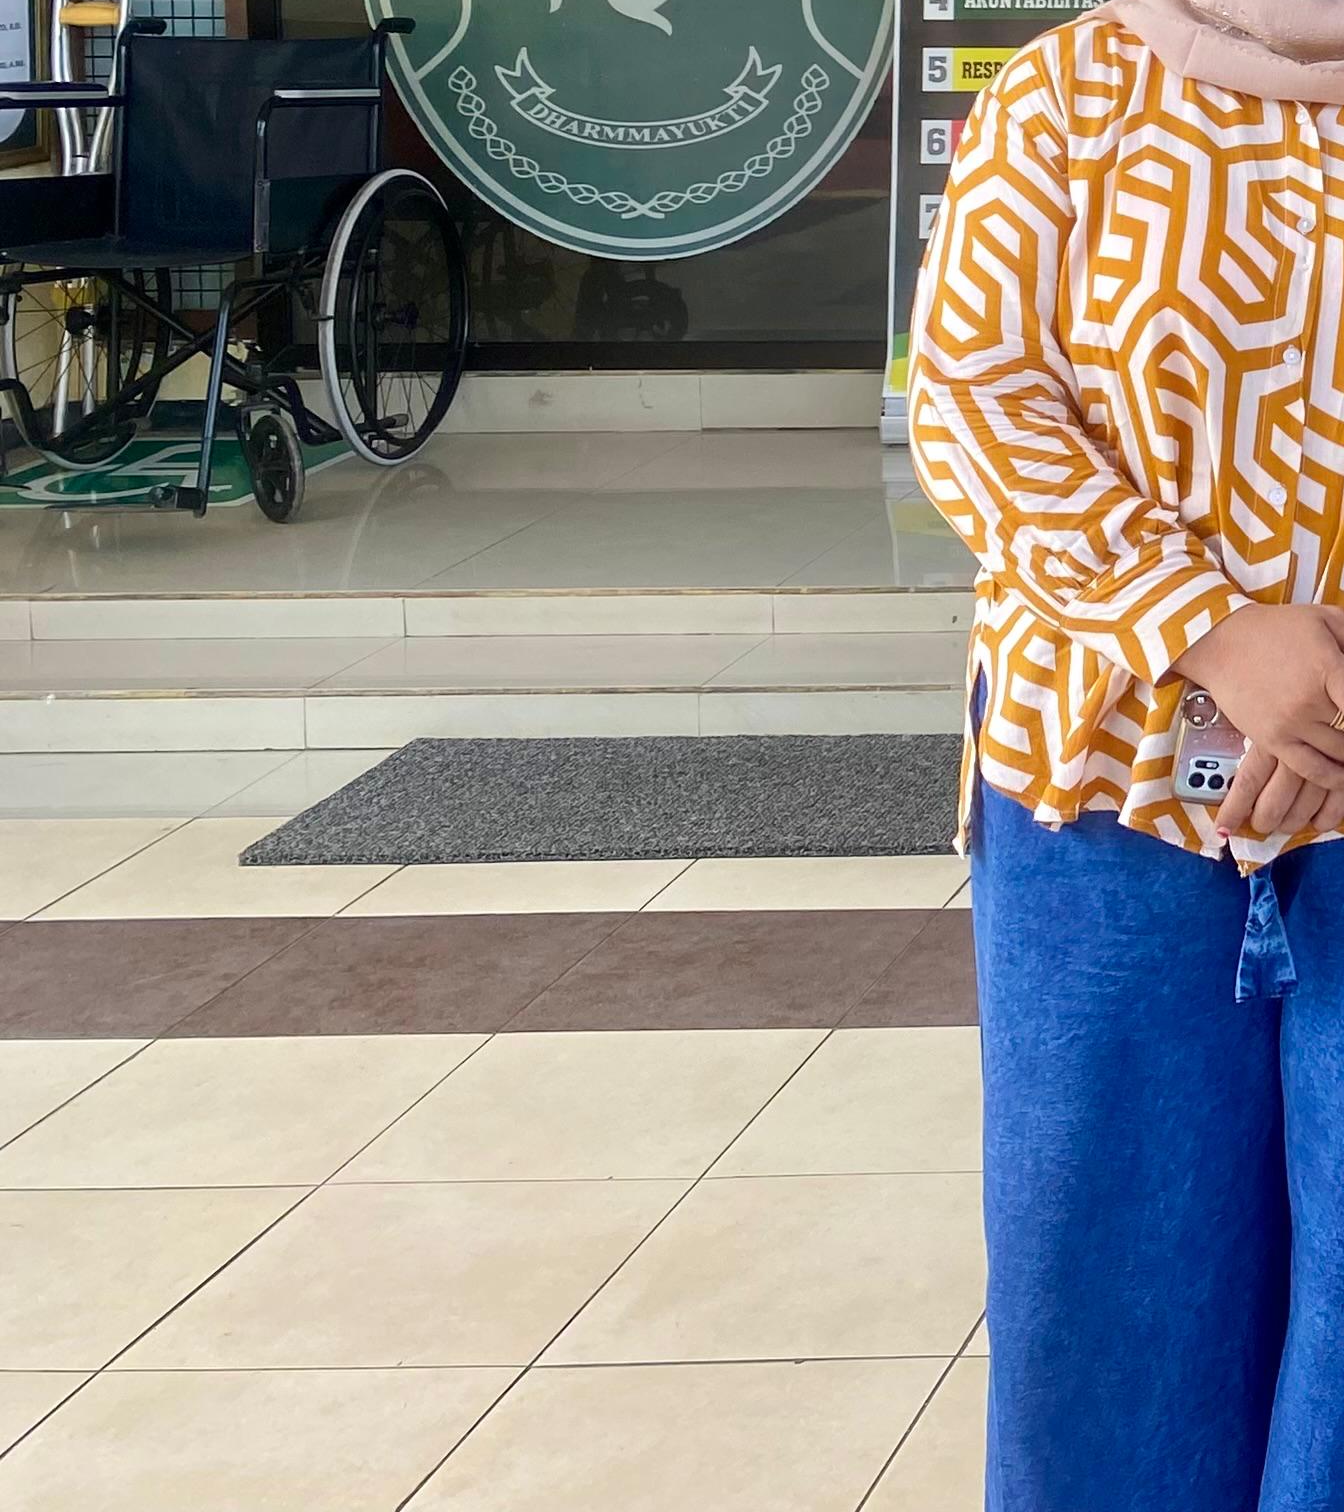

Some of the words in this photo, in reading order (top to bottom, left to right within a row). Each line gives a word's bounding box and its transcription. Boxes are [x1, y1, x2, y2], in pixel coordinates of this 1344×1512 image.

[928, 56, 947, 83] 5
[962, 61, 1007, 79] RESP
[528, 99, 756, 143] DHARMMAYUKTI
[927, 128, 946, 155] 6
